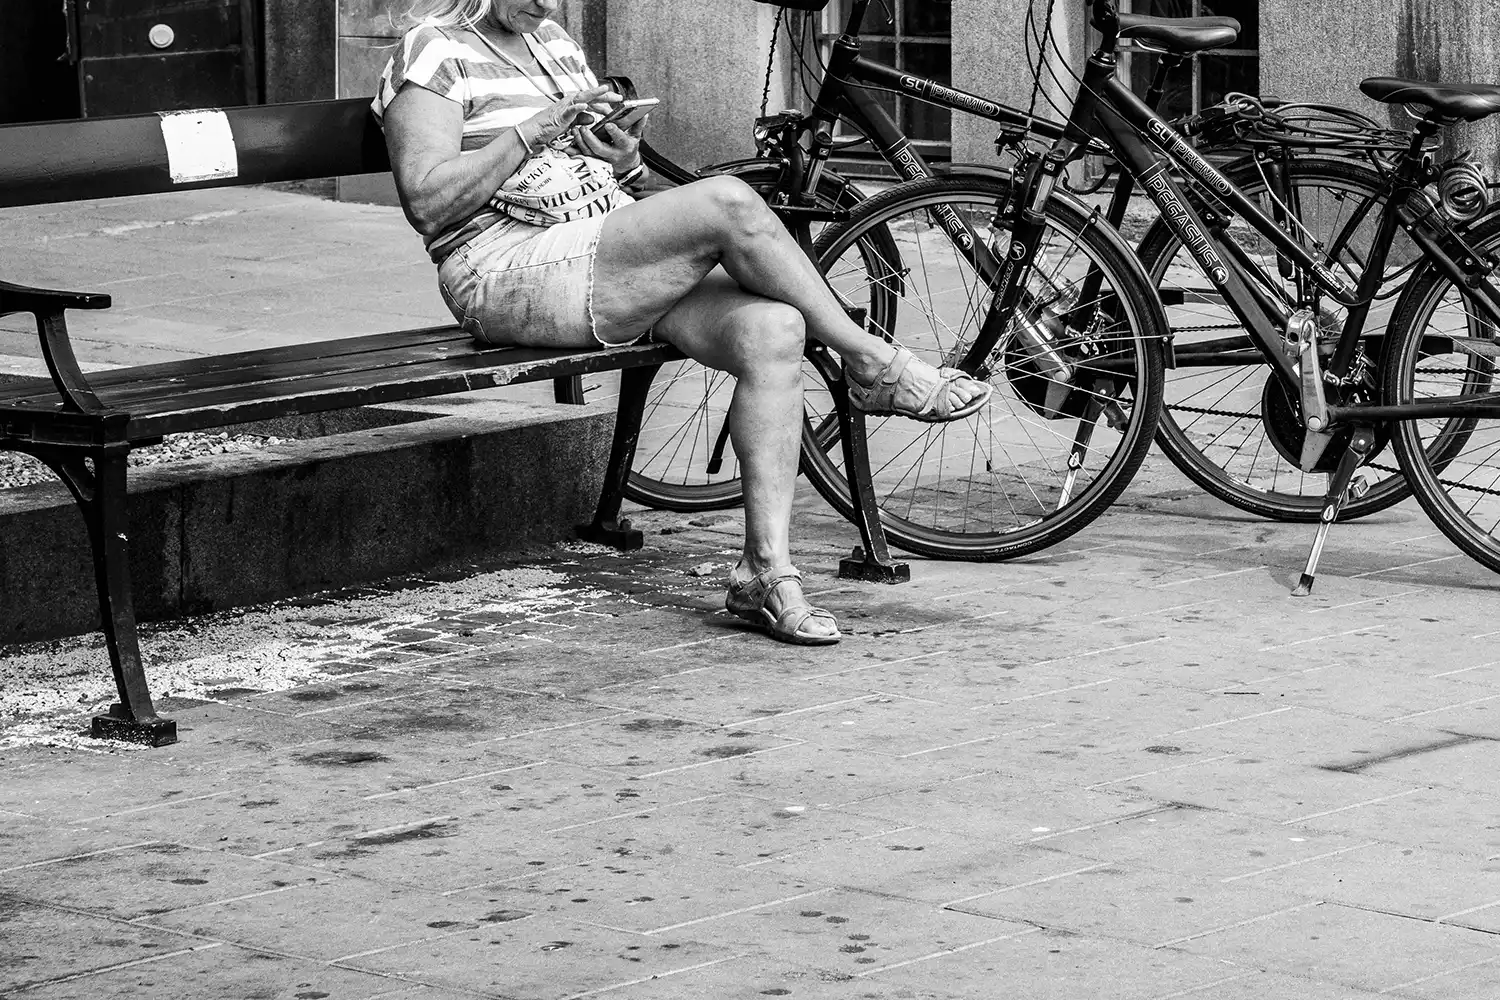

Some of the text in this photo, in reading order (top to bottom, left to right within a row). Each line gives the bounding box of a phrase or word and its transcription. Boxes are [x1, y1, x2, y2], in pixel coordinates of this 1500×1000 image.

[930, 83, 996, 117] PREMIO
[515, 161, 552, 194] MICKEY
[1174, 139, 1232, 196] PREMIO
[1147, 173, 1218, 269] PEGASUS
